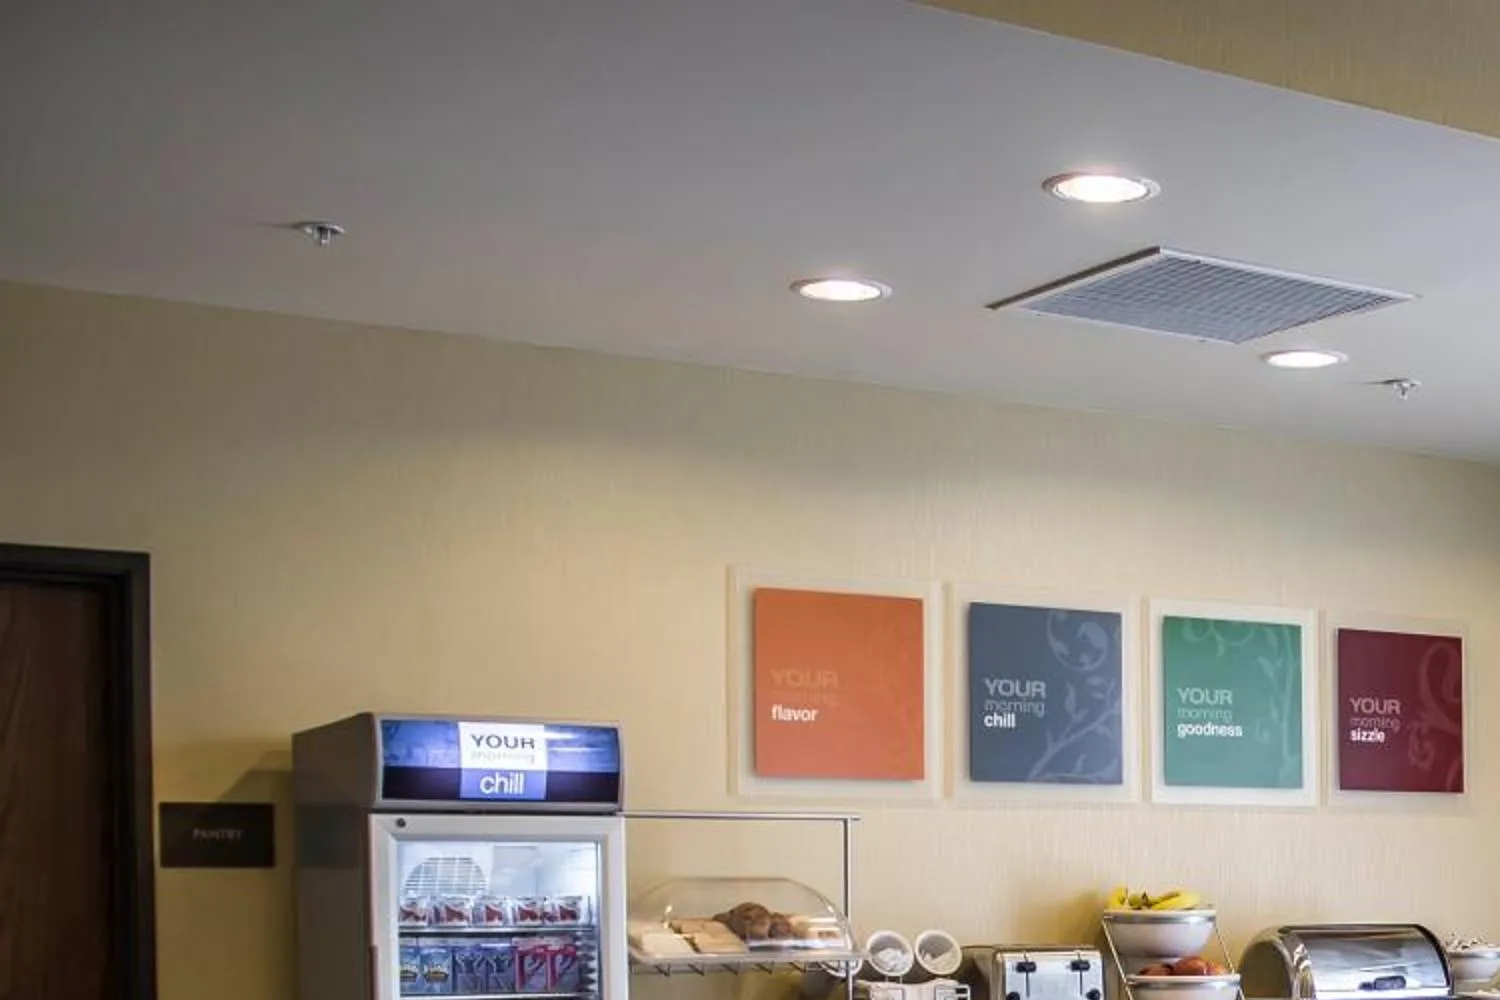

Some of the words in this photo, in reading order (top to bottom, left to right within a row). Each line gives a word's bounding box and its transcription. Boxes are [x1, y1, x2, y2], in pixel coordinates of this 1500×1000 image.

[985, 678, 1046, 699] YOUR
[1177, 687, 1233, 705] YOUR
[771, 703, 818, 722] flavor
[1349, 697, 1401, 715] YOUR
[983, 712, 1016, 728] chill
[1177, 722, 1243, 738] goodness
[1350, 728, 1385, 743] sizzle
[479, 771, 524, 794] chill
